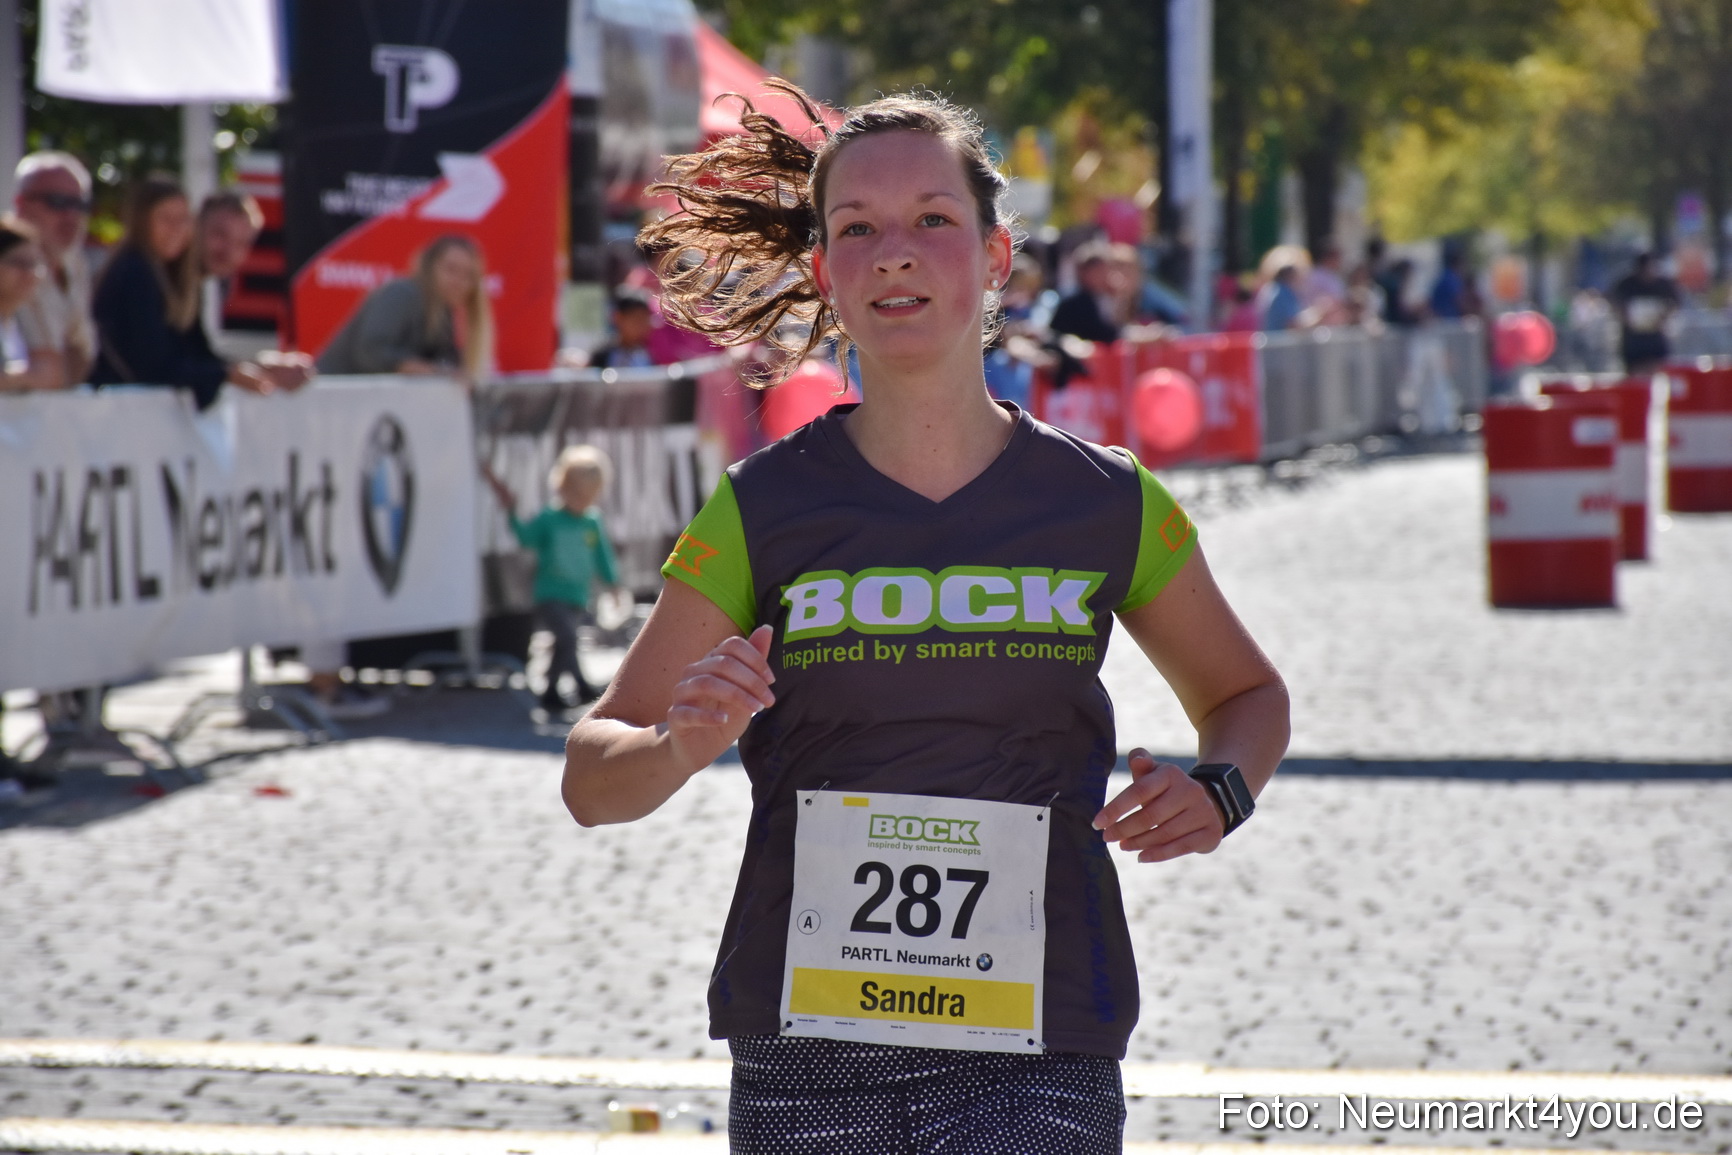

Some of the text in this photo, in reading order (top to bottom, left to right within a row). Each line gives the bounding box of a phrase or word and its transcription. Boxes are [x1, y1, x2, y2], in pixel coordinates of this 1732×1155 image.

[780, 567, 1104, 642] BOCK
[782, 639, 1097, 669] inspired by smart concepts
[869, 814, 981, 846] BOCK
[867, 840, 982, 856] inspired by smart concepts
[849, 861, 990, 940] 287
[803, 915, 813, 929] A
[841, 946, 971, 968] PARTL Neumarkt
[859, 980, 966, 1018] Sandra
